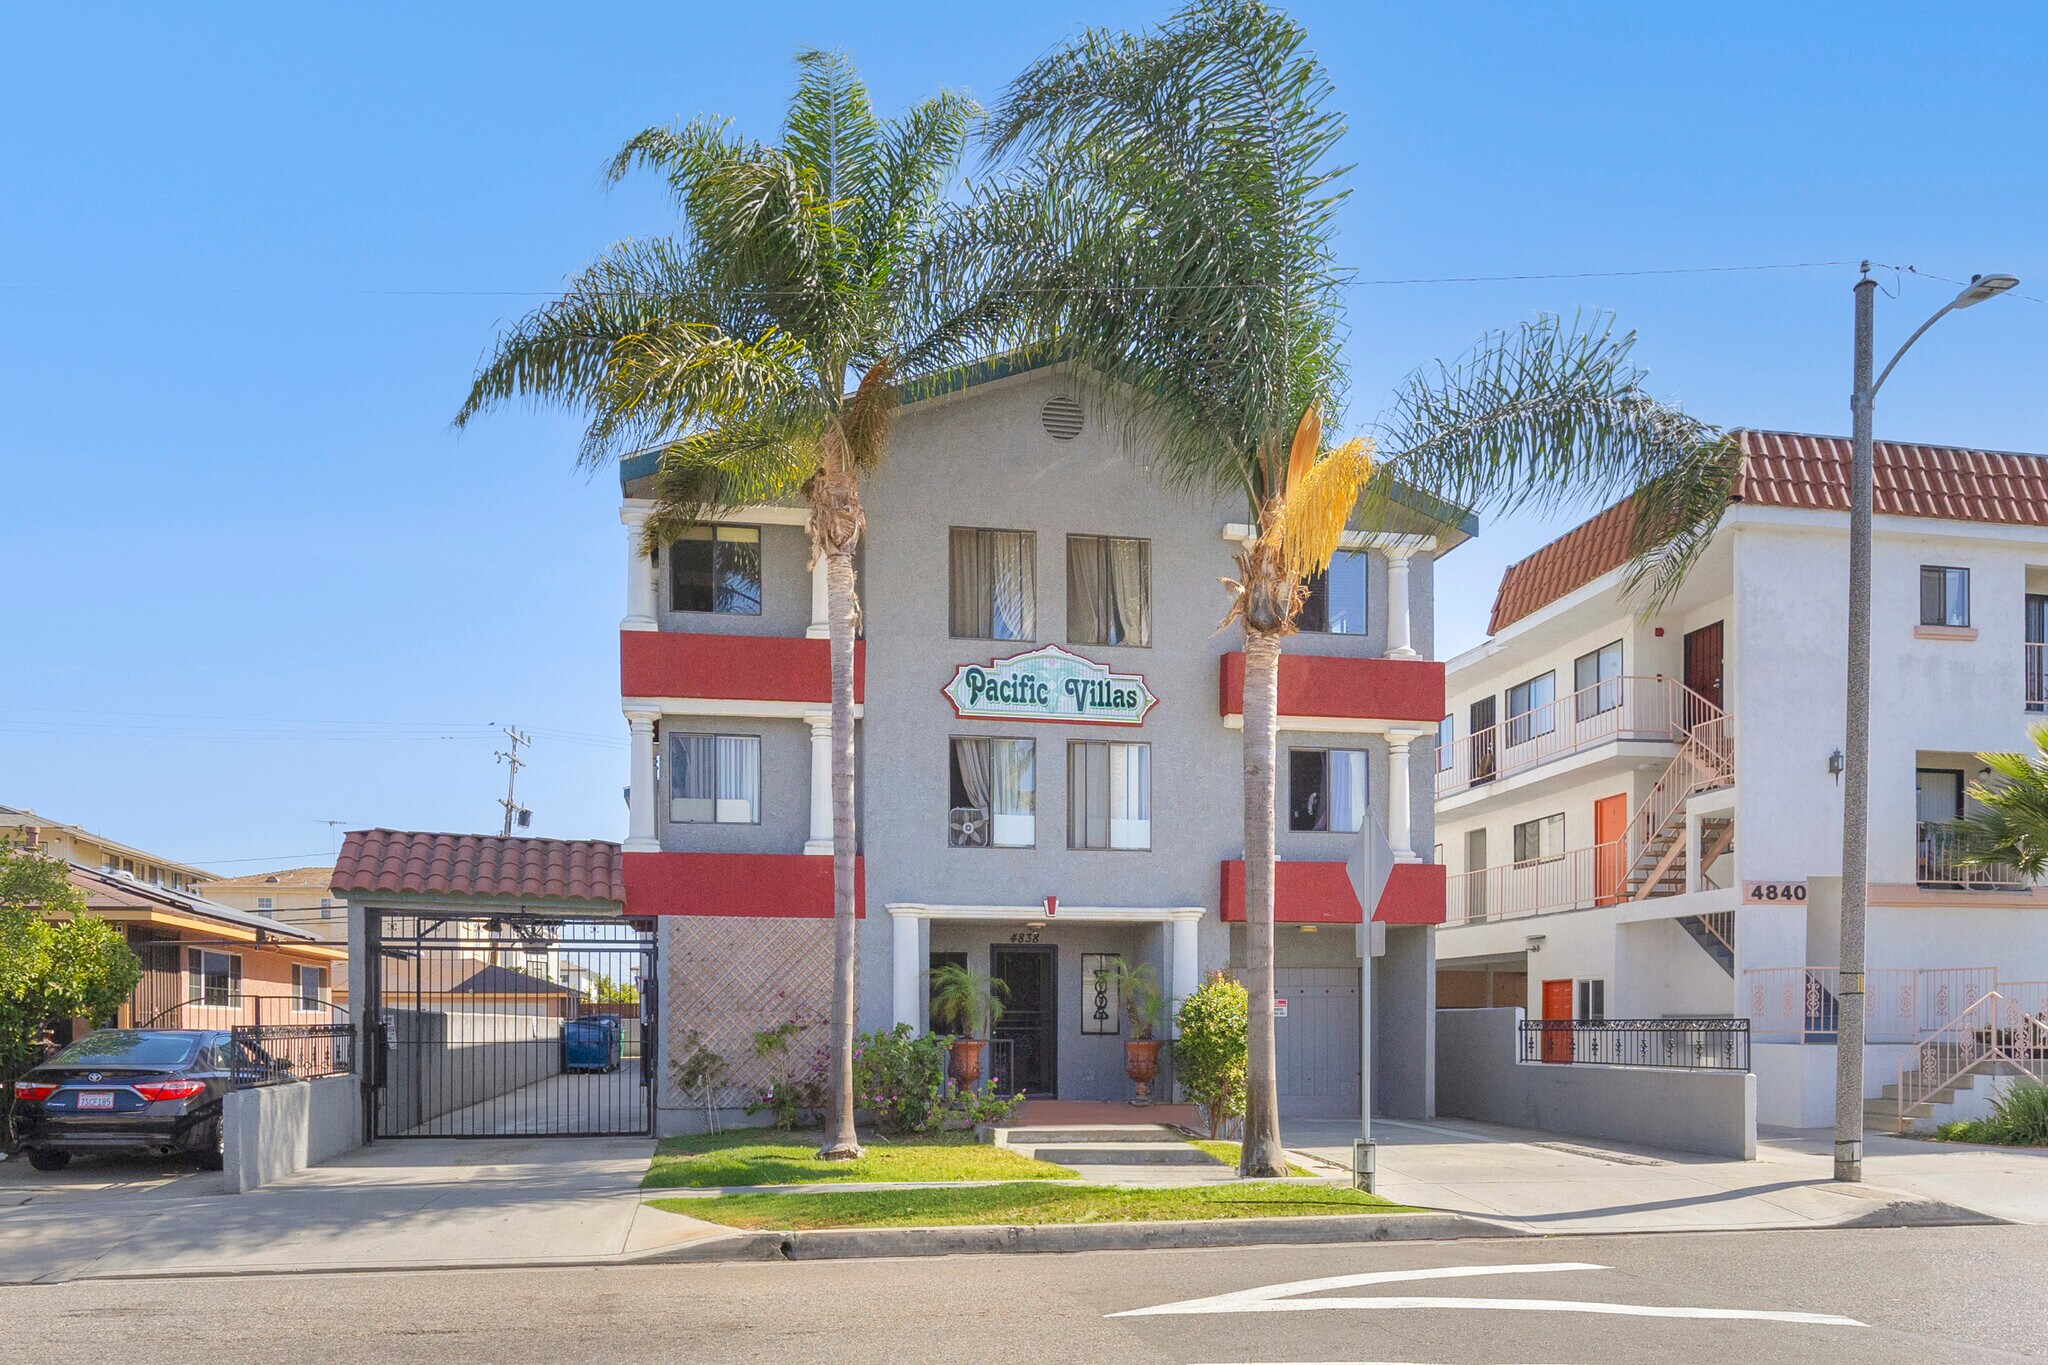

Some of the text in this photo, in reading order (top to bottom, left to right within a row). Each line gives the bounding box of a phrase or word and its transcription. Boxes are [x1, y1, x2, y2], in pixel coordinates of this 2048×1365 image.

[965, 667, 1138, 712] Pacific Villas
[1751, 884, 1807, 900] 4840
[1009, 932, 1040, 943] 4838
